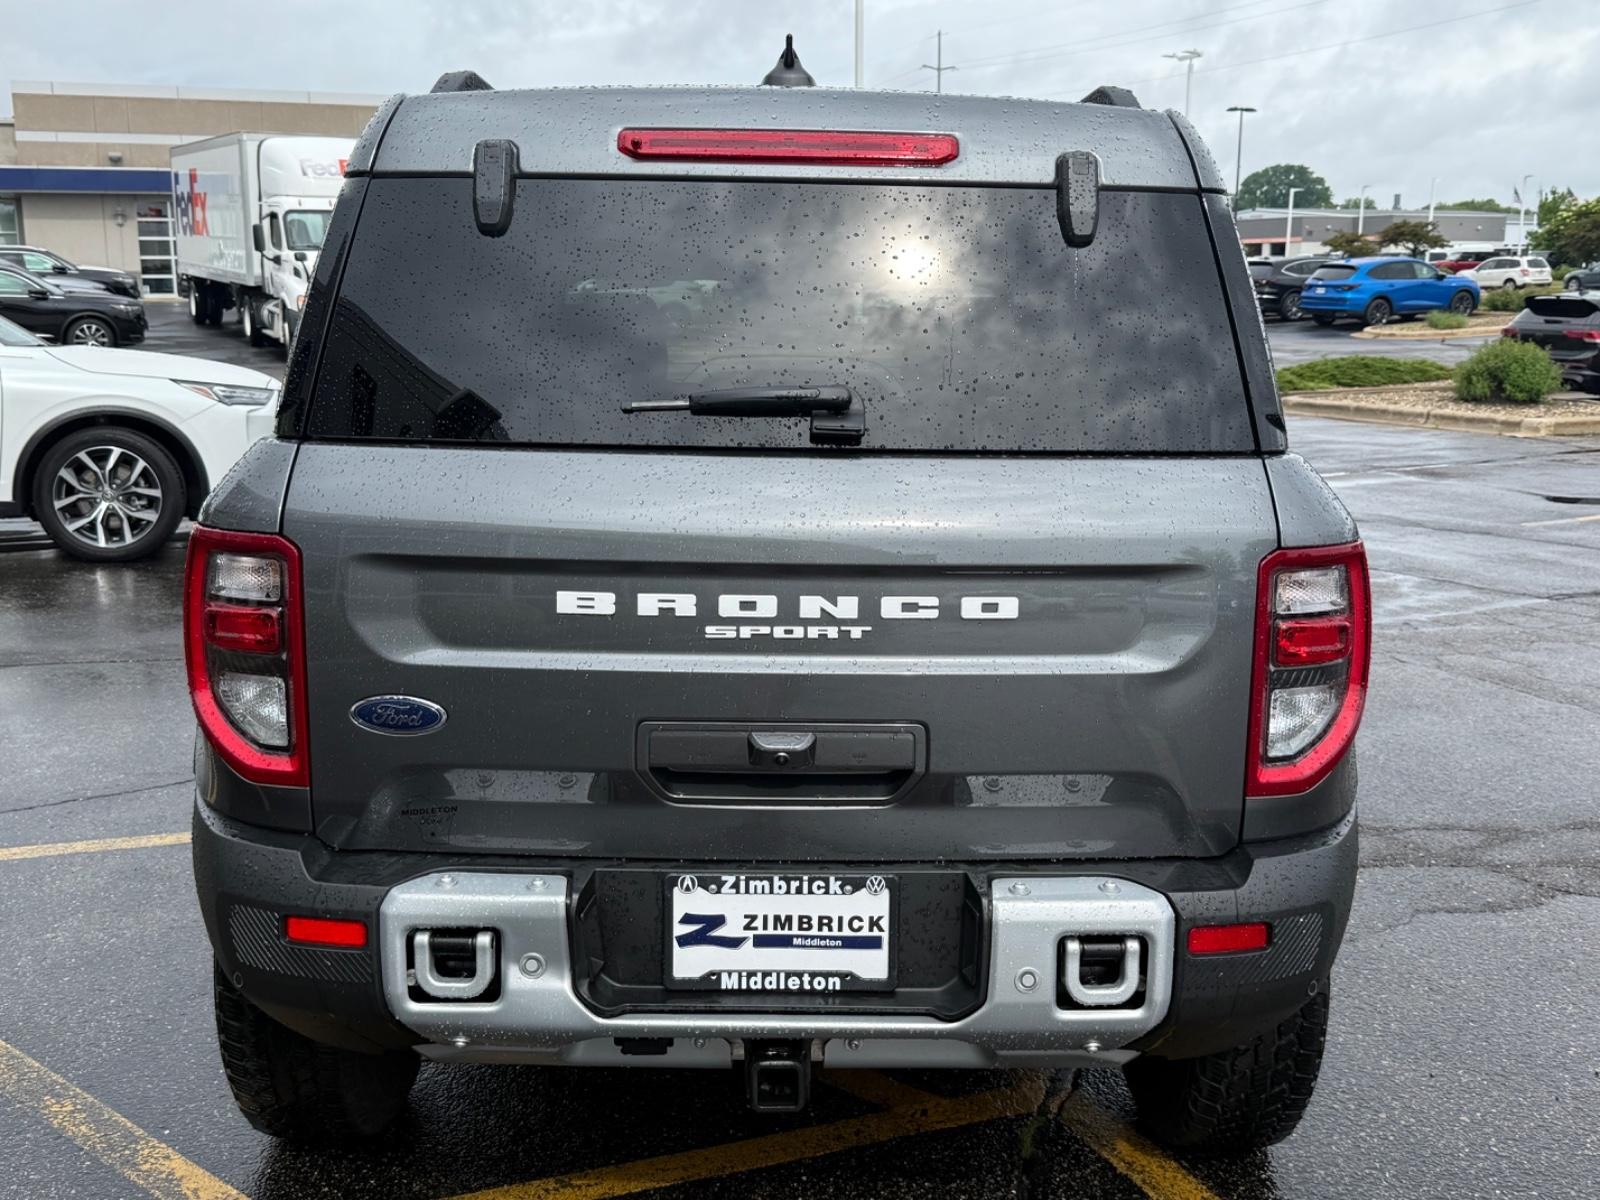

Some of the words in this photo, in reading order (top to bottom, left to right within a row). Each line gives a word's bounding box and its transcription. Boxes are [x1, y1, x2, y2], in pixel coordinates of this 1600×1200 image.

[173, 168, 210, 237] FedEx
[556, 591, 1019, 620] BRONCO
[704, 625, 872, 639] SPORT
[371, 703, 422, 726] Ford
[401, 806, 458, 816] MIDDLETON
[720, 875, 843, 895] Zimbrick
[743, 914, 885, 933] ZIMBRICK
[792, 937, 843, 947] Middleton
[720, 971, 841, 991] Middleton
